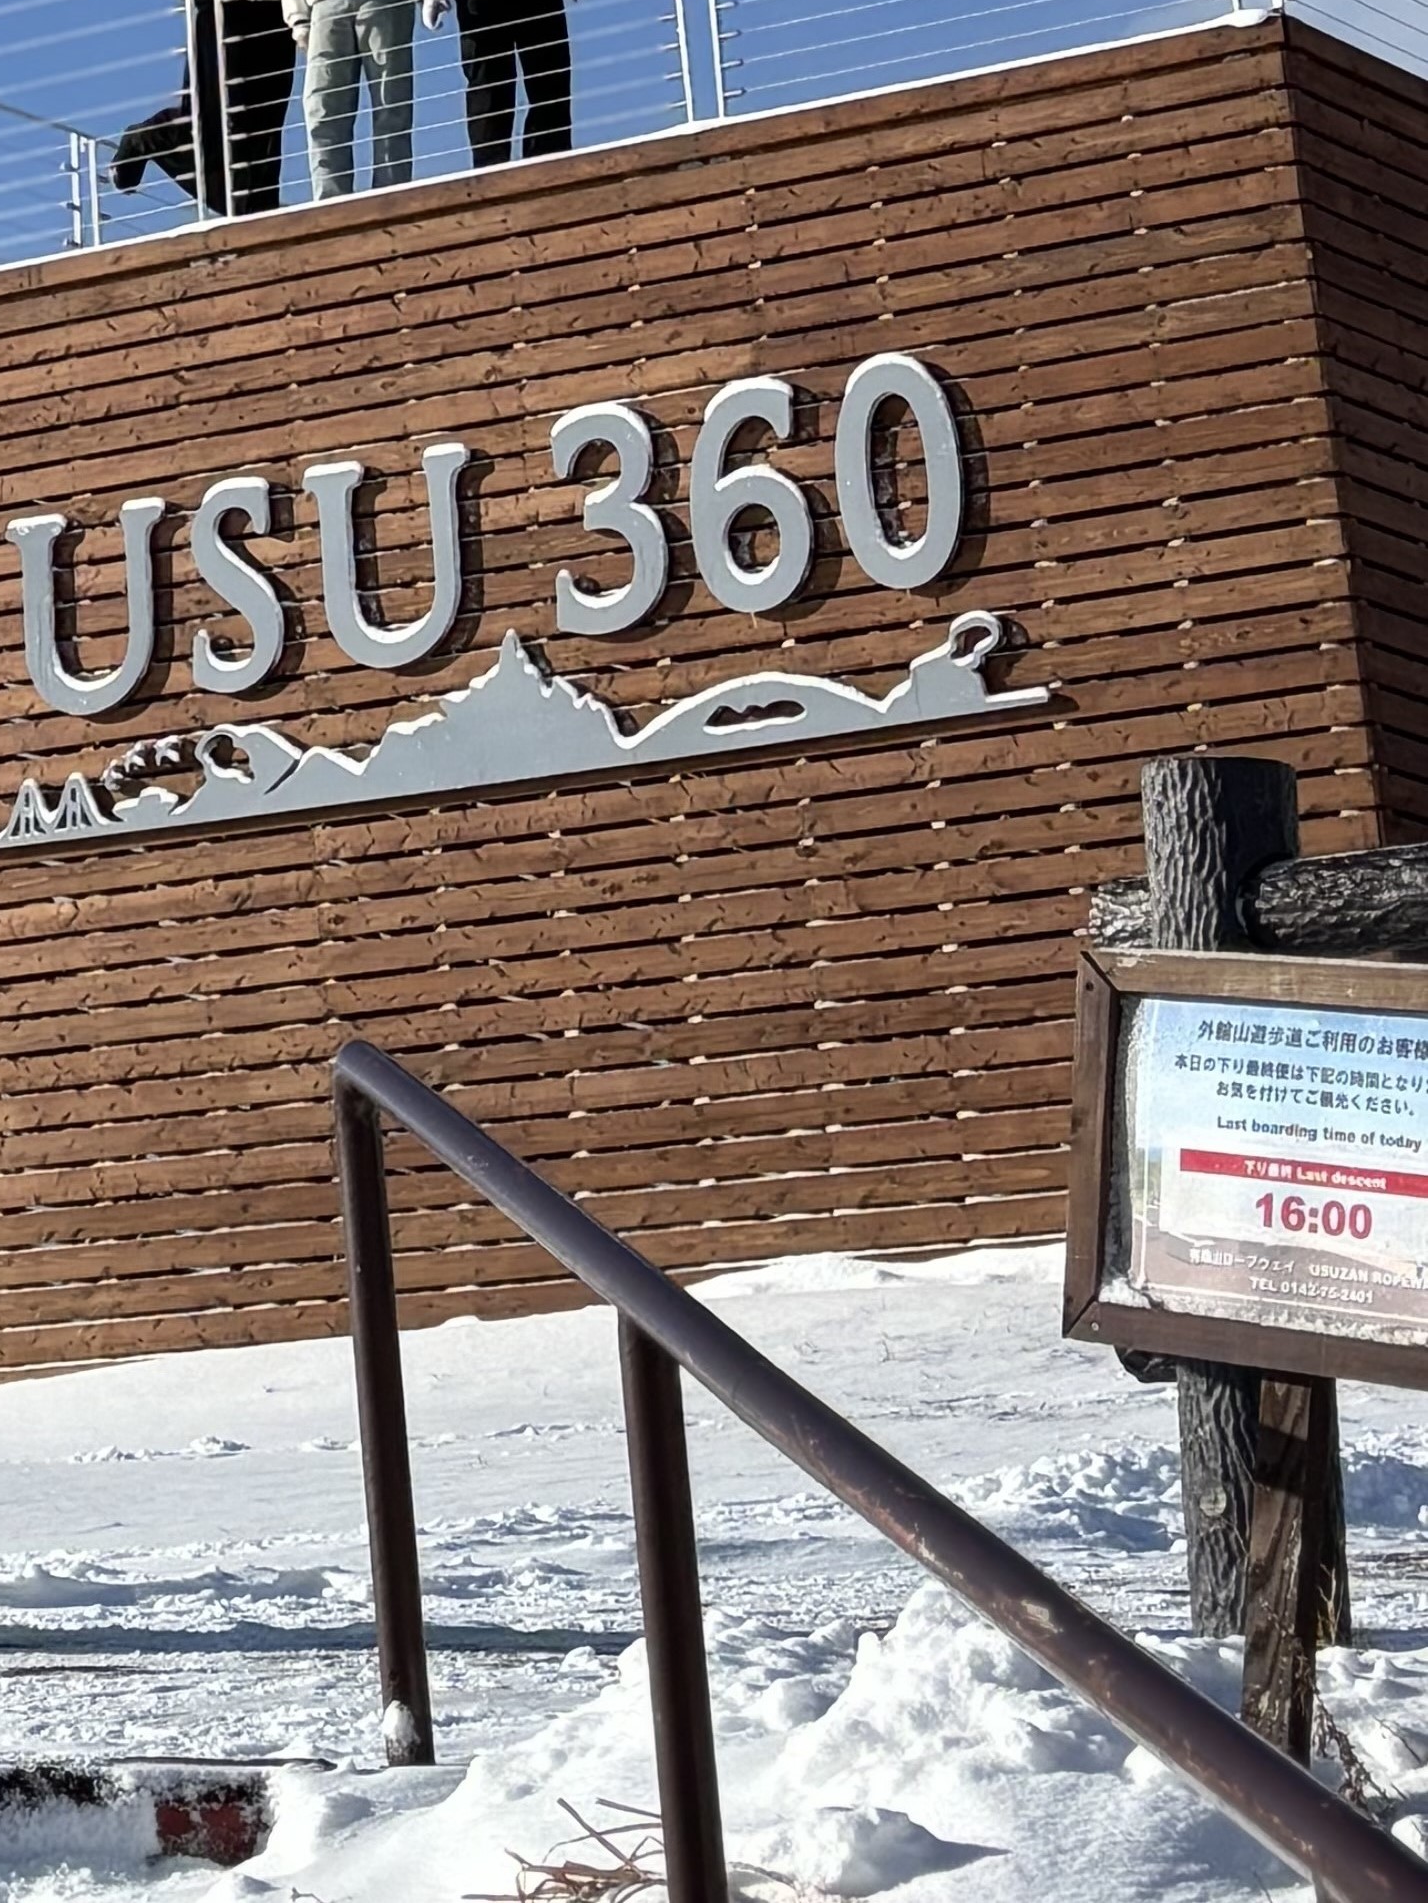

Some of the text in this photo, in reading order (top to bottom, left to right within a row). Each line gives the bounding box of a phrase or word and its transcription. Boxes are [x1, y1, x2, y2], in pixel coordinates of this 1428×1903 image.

[6, 353, 961, 715] USU 360
[1174, 1052, 1428, 1094] 本日の下り最終便は下記の時間となり
[1216, 1115, 1422, 1153] Last boarding time of today
[1296, 1166, 1328, 1183] Last
[1255, 1192, 1373, 1239] 16:00
[1249, 1276, 1278, 1292] TEL
[1308, 1264, 1369, 1283] USUZAN
